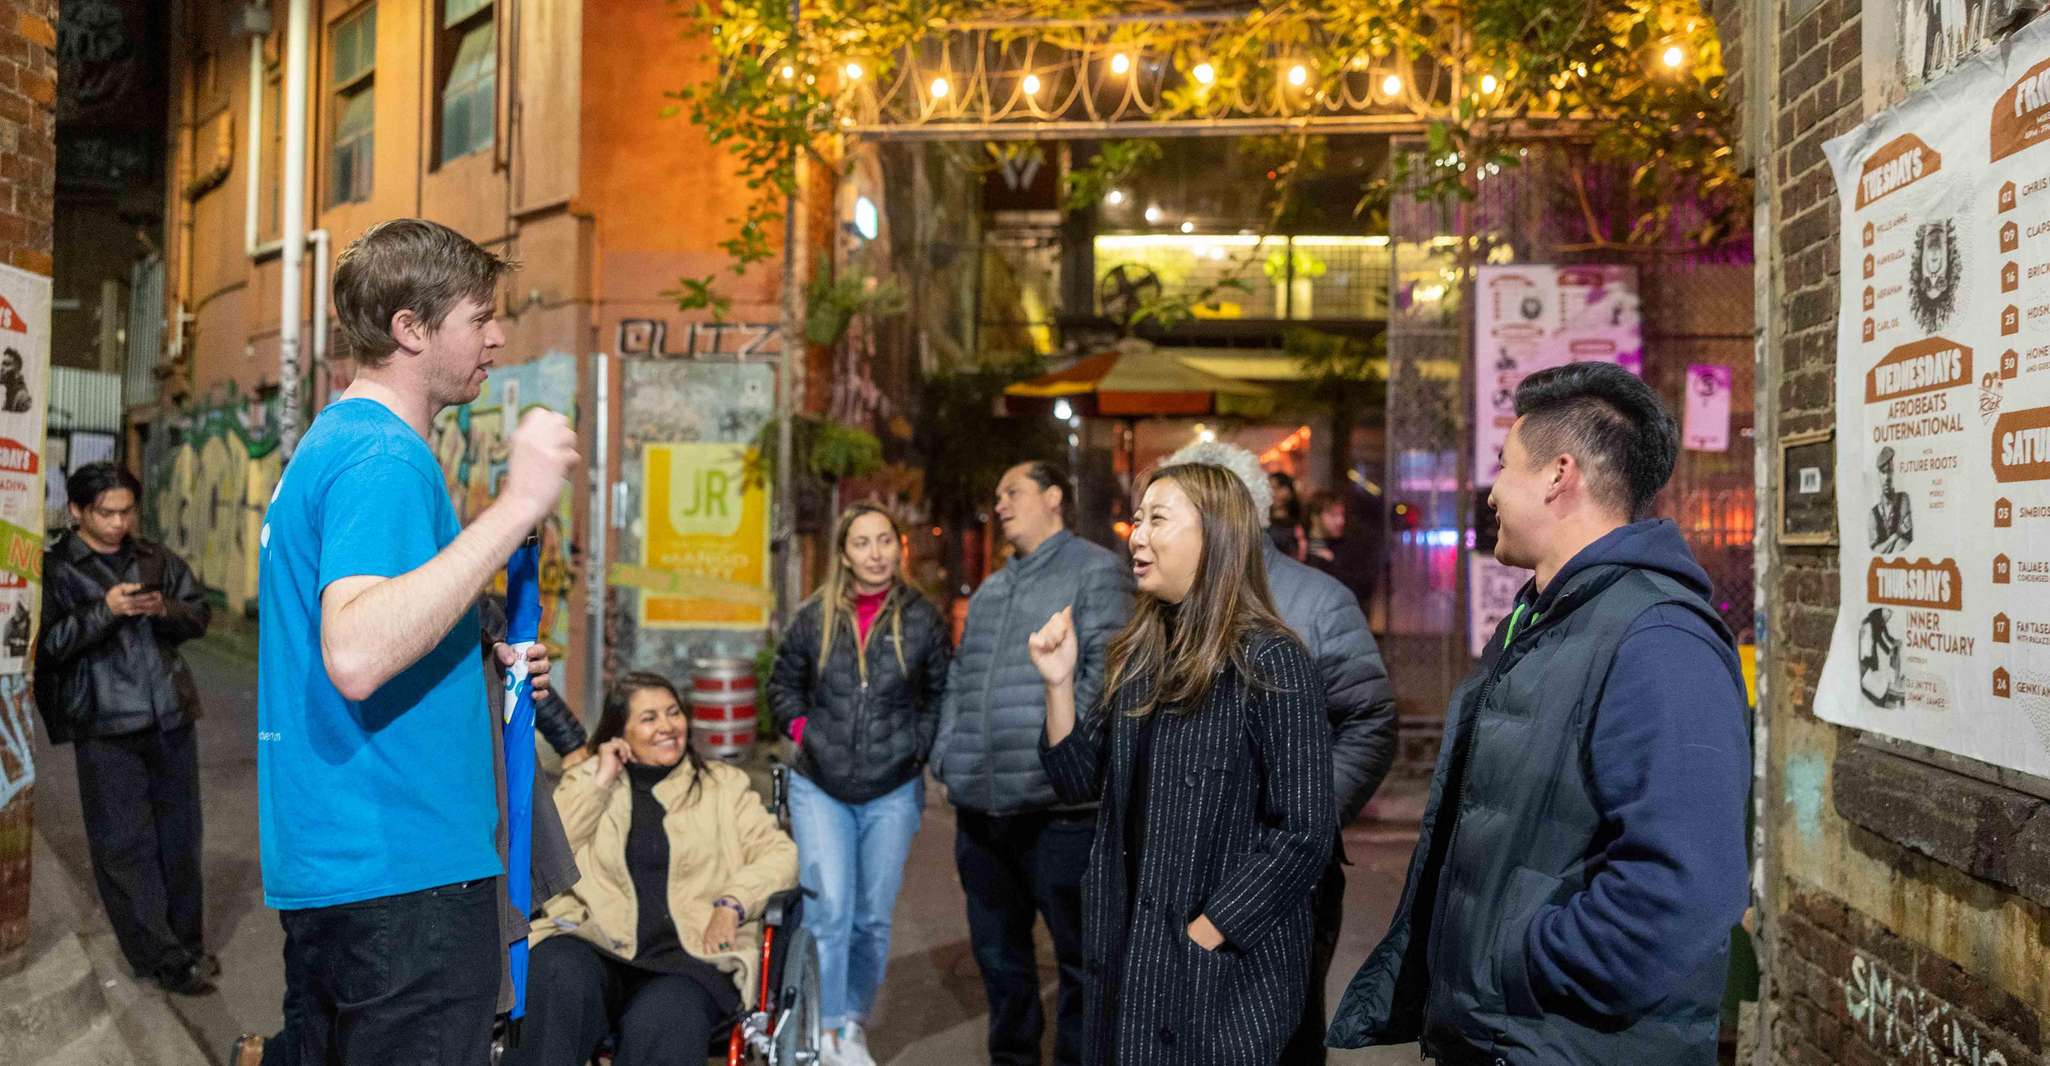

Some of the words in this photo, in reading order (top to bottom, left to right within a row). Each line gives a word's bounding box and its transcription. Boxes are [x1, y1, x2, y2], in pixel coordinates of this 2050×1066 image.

[1863, 146, 1922, 205] TUESDAYS
[1874, 348, 1962, 396] WEDNESDAYS
[1888, 393, 1947, 420] AFROBEATS
[1873, 413, 1964, 443] OUTERNATIONAL
[1900, 458, 1929, 473] FUTURE
[1930, 455, 1957, 471] ROOTS
[683, 468, 728, 518] JR
[1876, 568, 1951, 603] THURSDAYS
[1906, 610, 1940, 631] INNER
[1906, 630, 1975, 656] SANCTUARY
[2017, 682, 2040, 696] GENKI
